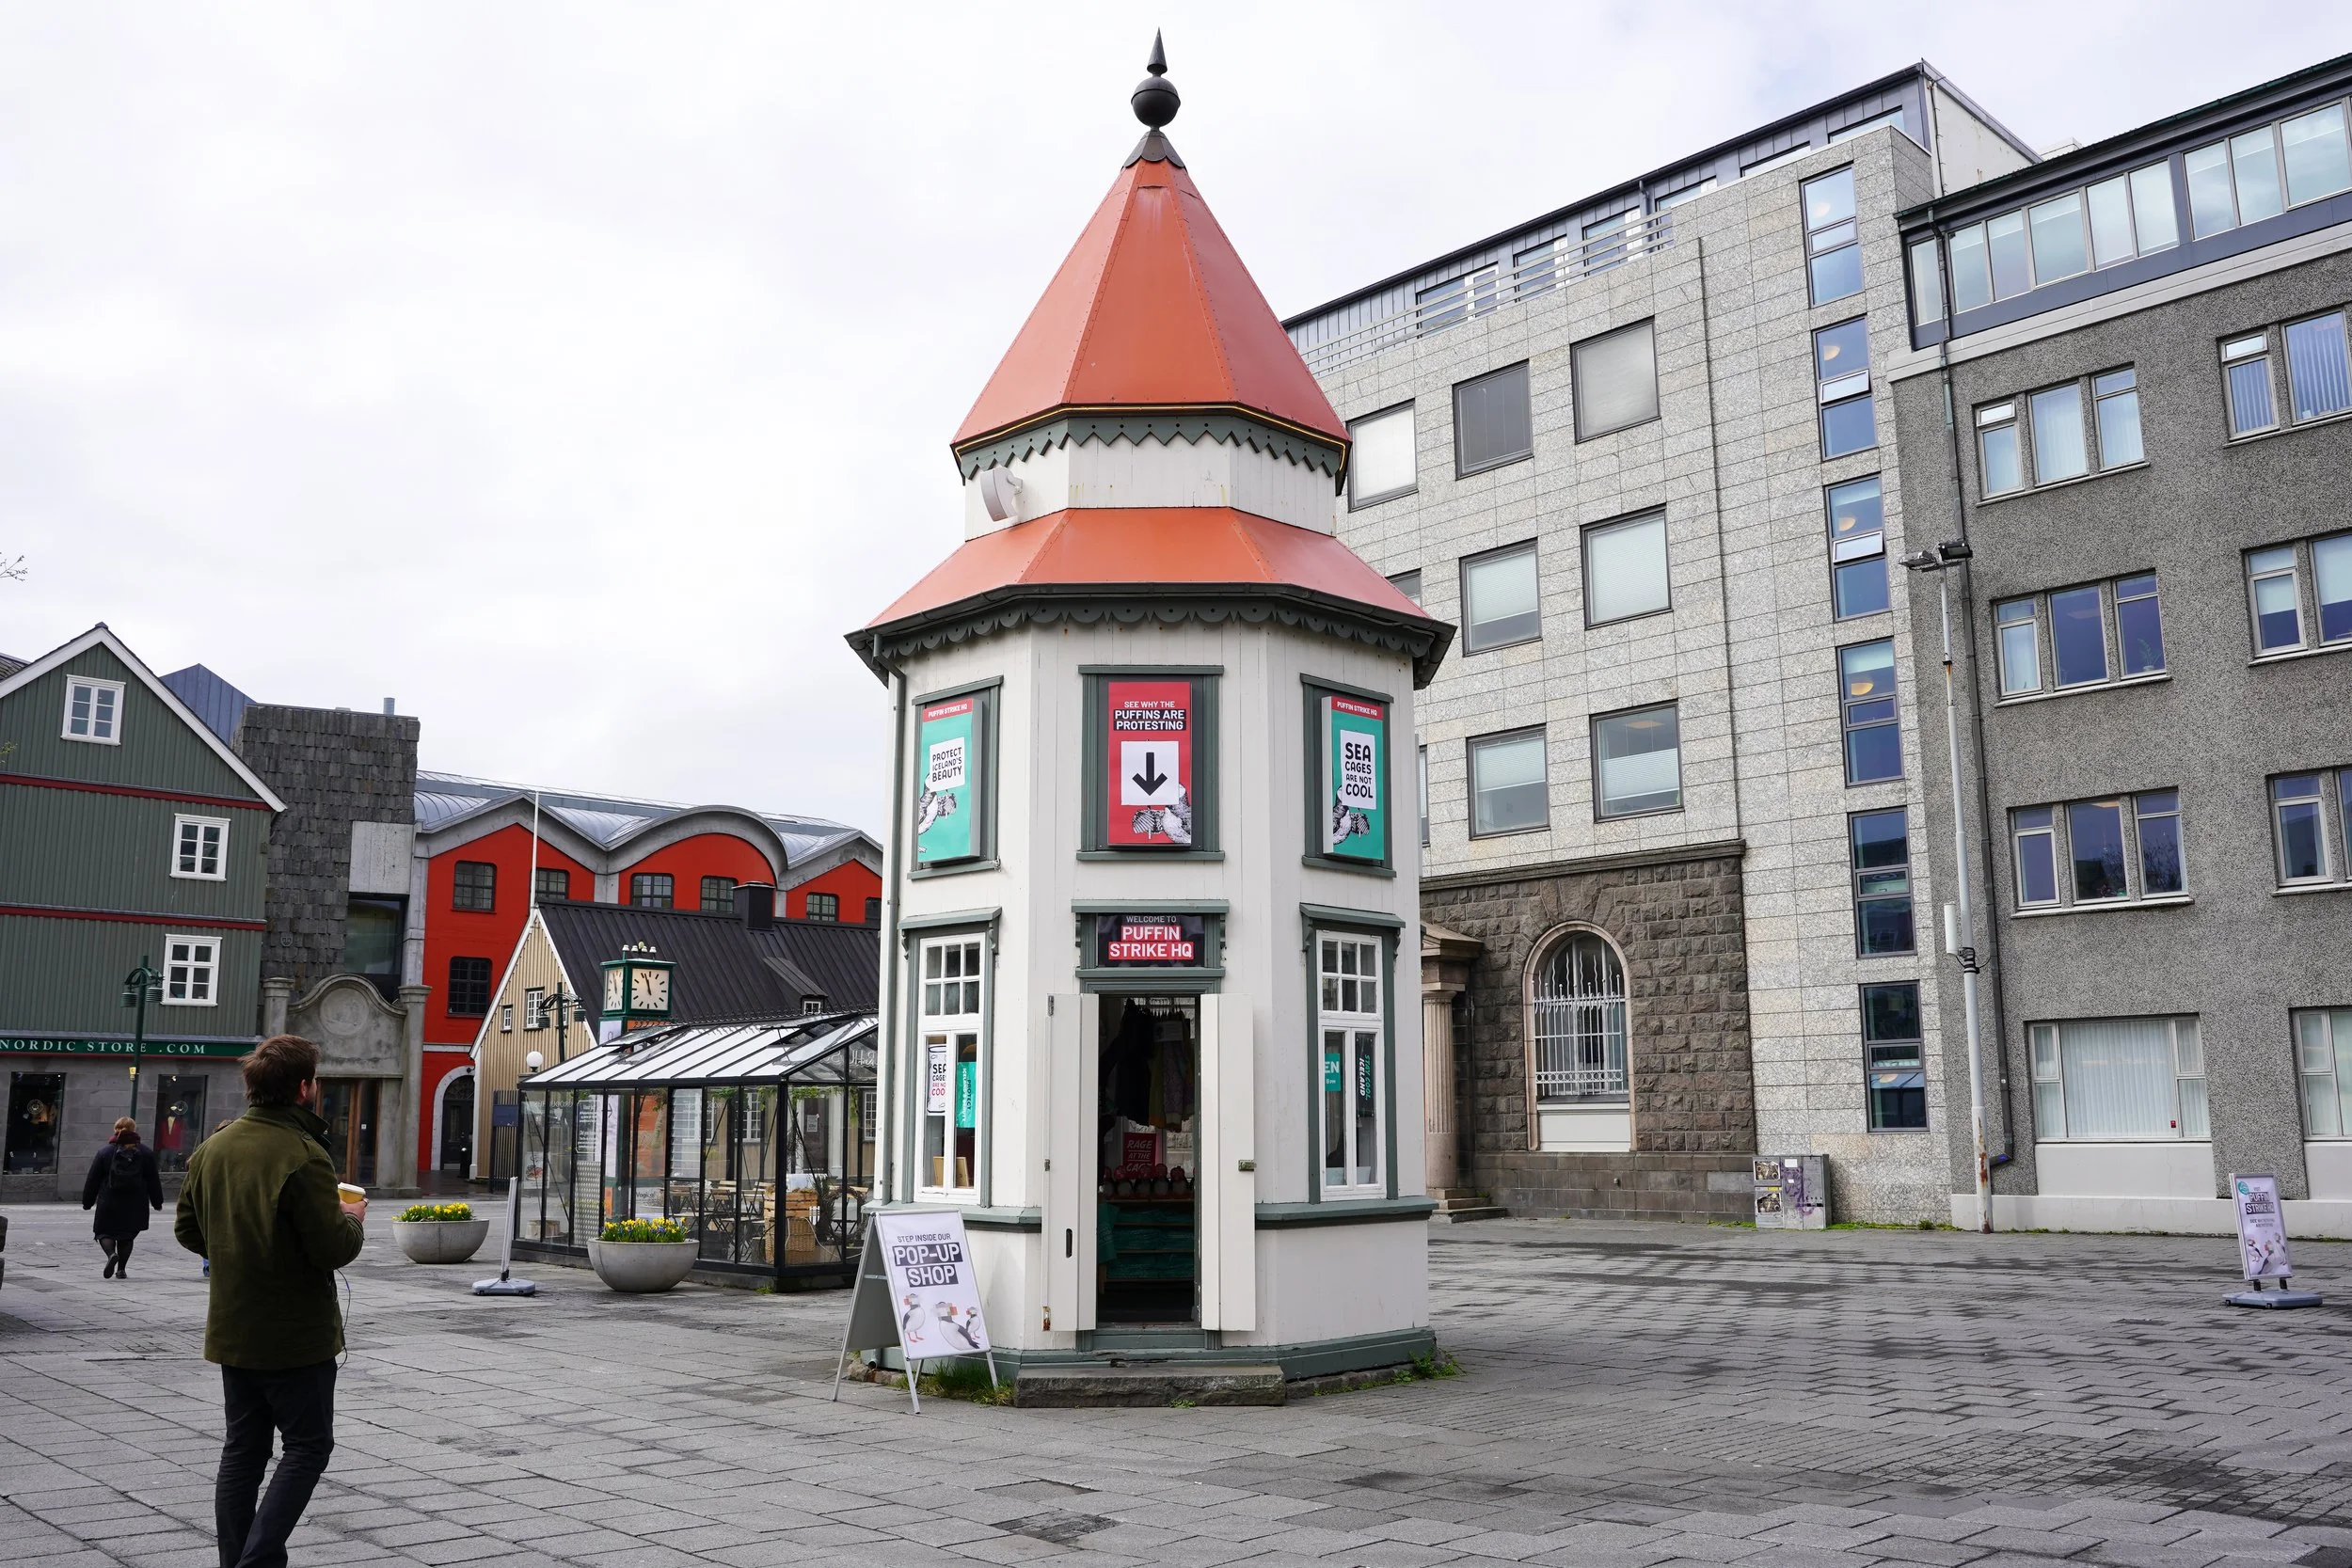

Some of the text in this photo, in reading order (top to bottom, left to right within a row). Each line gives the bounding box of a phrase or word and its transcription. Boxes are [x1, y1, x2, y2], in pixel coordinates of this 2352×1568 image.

[928, 709, 944, 718] PUFFIN
[944, 705, 961, 715] STRIKE
[1115, 710, 1184, 720] PUFFINS ARE
[1337, 701, 1353, 711] PUFFIN
[1354, 705, 1370, 715] STRIKE
[1116, 721, 1184, 730] PROTESTING
[932, 747, 961, 762] PROTECT
[1345, 742, 1371, 762] SEA
[932, 756, 961, 771] ICELAND'S
[1345, 761, 1372, 775] CAGES
[932, 766, 961, 782] BEAUTY
[1346, 774, 1372, 784] ARE NOT
[1345, 784, 1374, 799] COOL
[1122, 927, 1180, 940] PUFFIN
[1110, 943, 1192, 958] STRIKE HQ
[0, 1039, 76, 1052] NORDIC
[87, 1041, 147, 1053] STORE
[1325, 1061, 1340, 1073] EN
[1127, 1139, 1152, 1148] RAGE
[894, 1243, 960, 1265] POP-UP
[907, 1265, 955, 1286] SHOP
